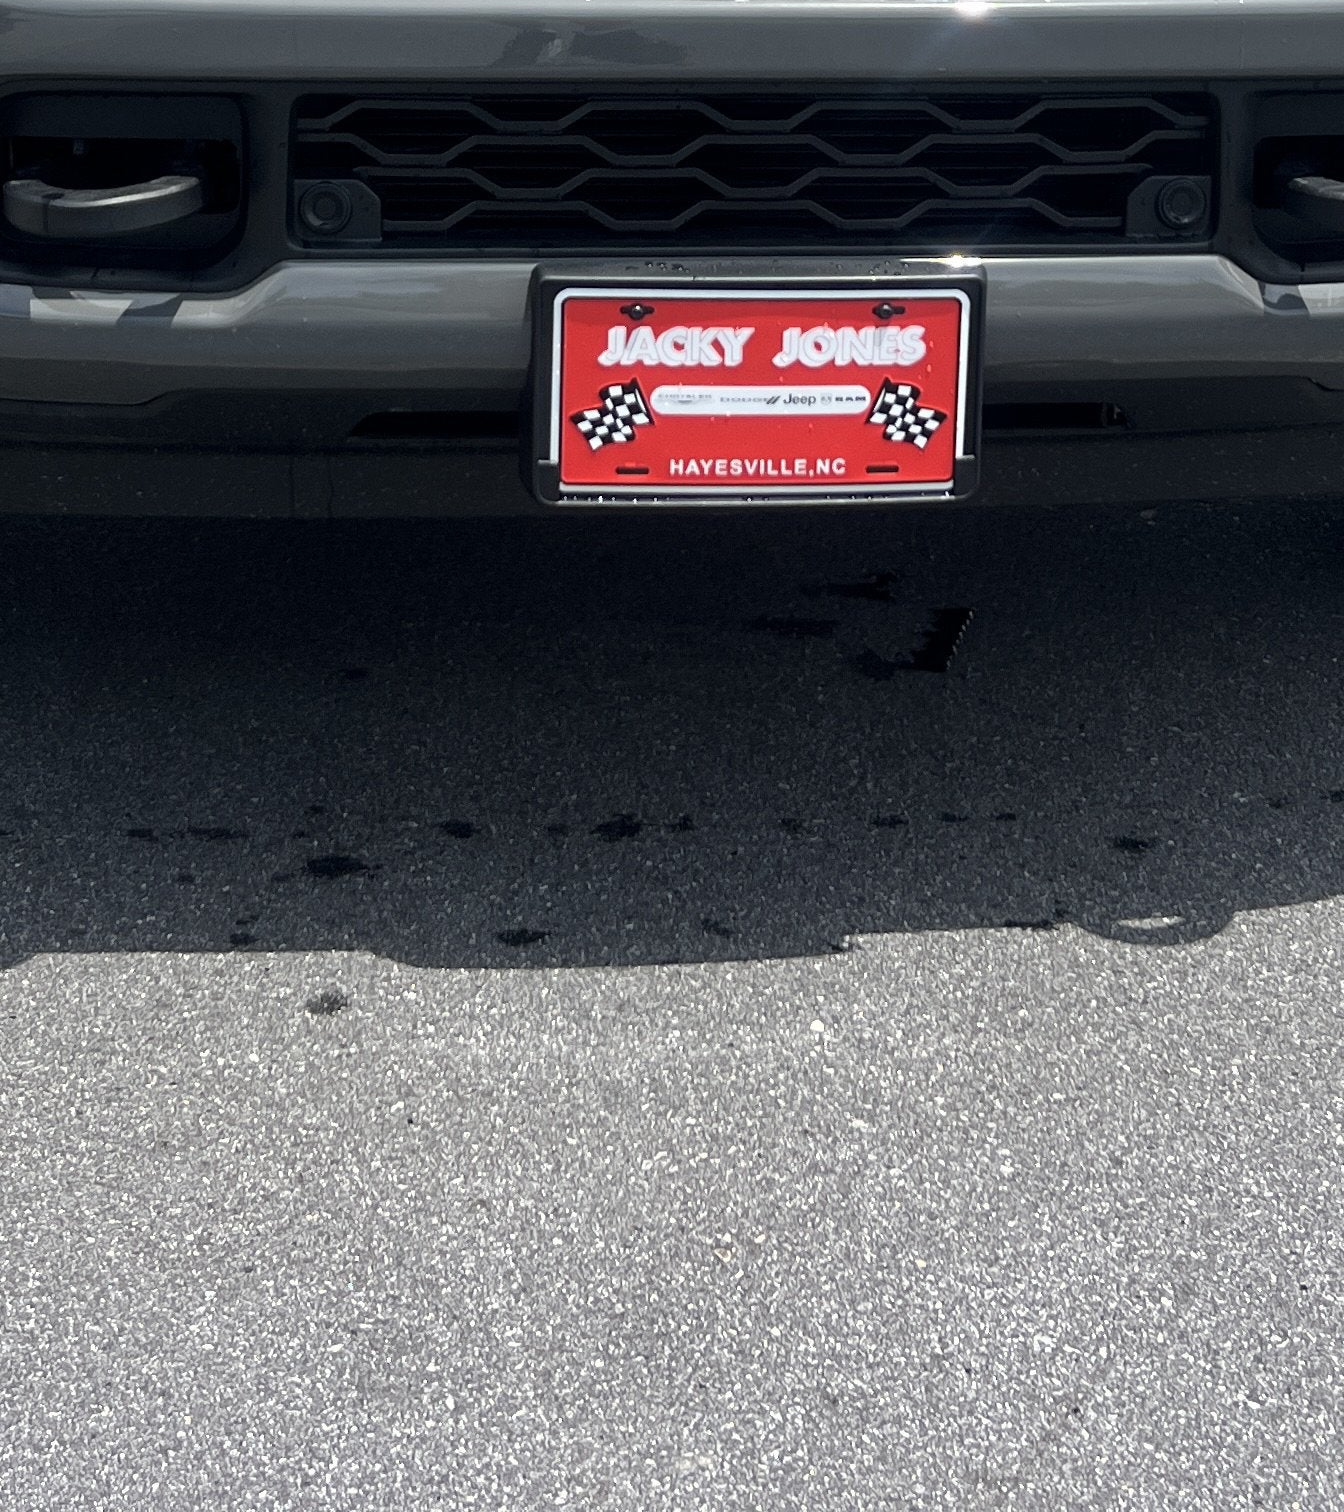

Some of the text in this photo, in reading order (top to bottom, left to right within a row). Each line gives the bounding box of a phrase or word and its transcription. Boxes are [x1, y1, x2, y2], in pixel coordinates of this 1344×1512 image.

[597, 325, 927, 367] JACKY JONES
[783, 393, 817, 407] Jeep
